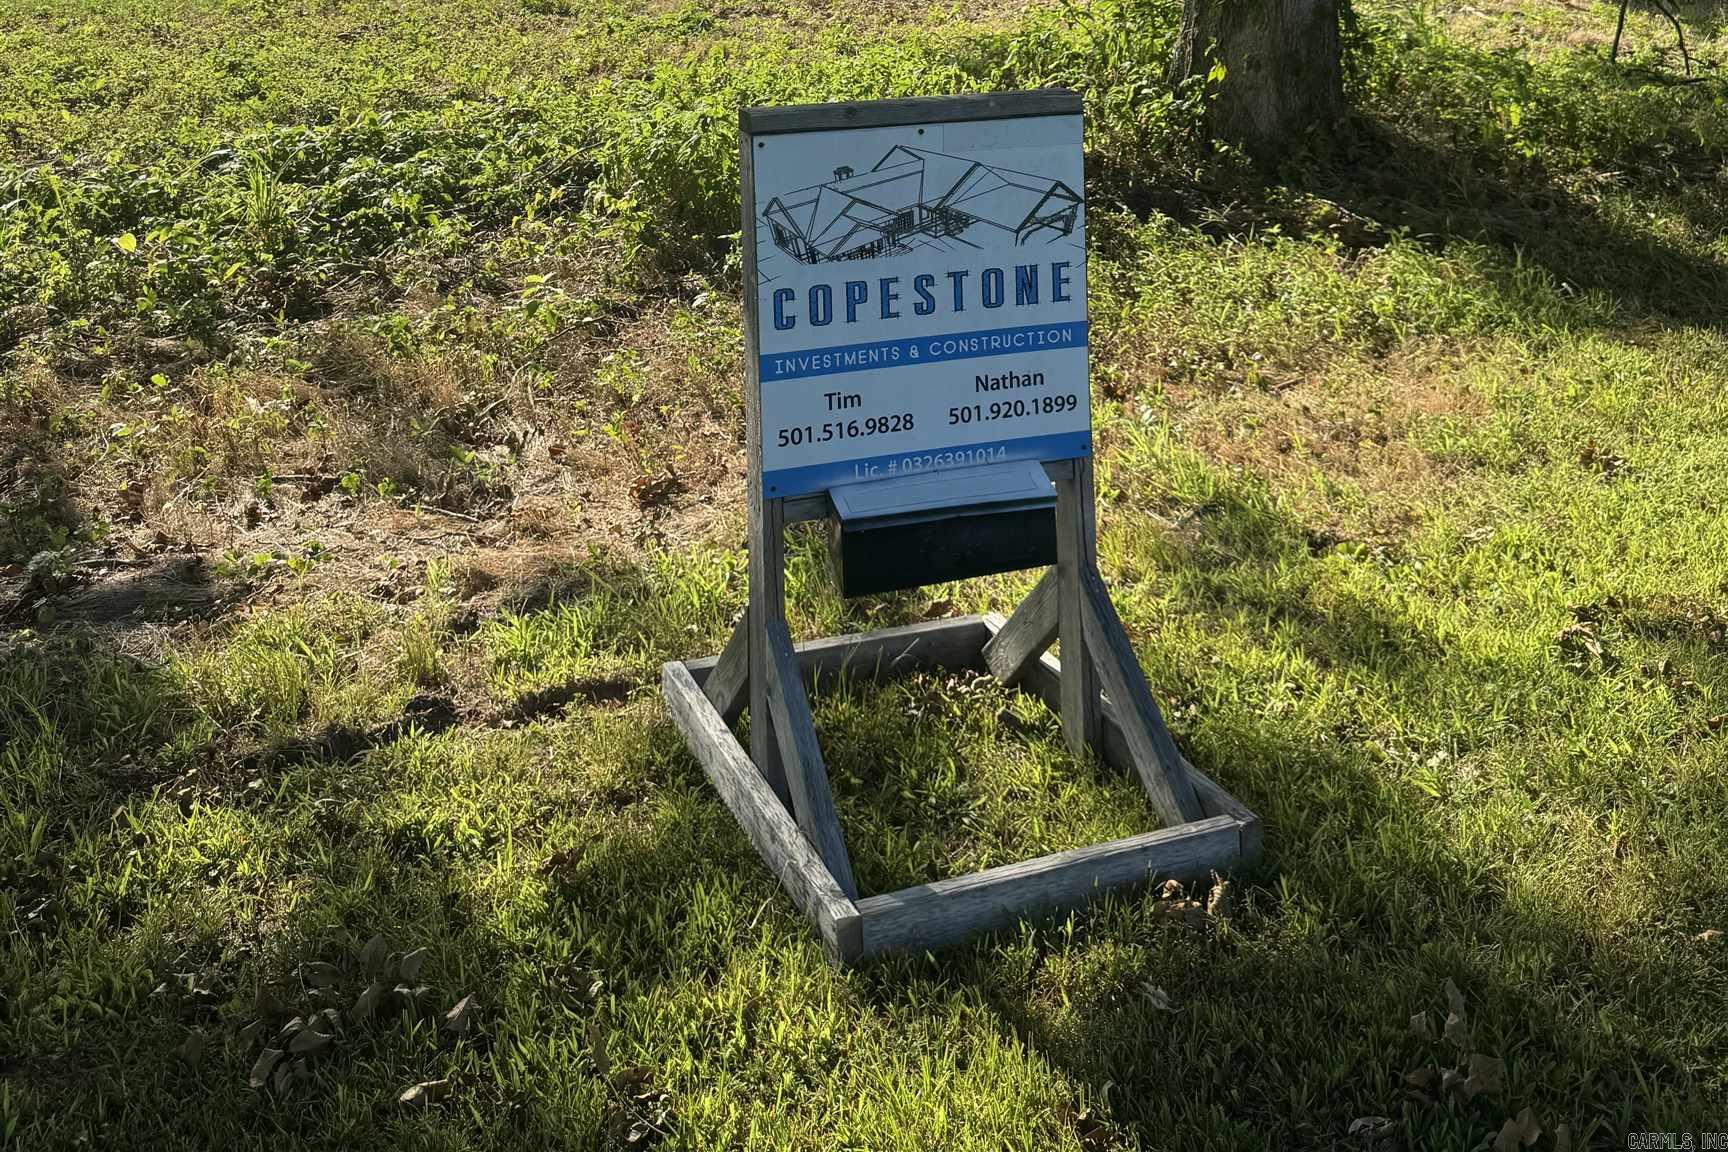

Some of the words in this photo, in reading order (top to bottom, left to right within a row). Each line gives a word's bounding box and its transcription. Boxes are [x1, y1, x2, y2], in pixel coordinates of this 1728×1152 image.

[773, 261, 1072, 331] COPESTONE
[775, 345, 900, 374] INVESTMENTS
[909, 344, 921, 358] &
[929, 328, 1073, 356] CONSTRUCTION
[975, 370, 1045, 393] Nathan
[824, 391, 862, 411] Tim
[949, 394, 1078, 425] 501.920.1899
[778, 413, 914, 447] 501.516.9828
[855, 463, 883, 479] Lic.
[887, 459, 898, 476] #
